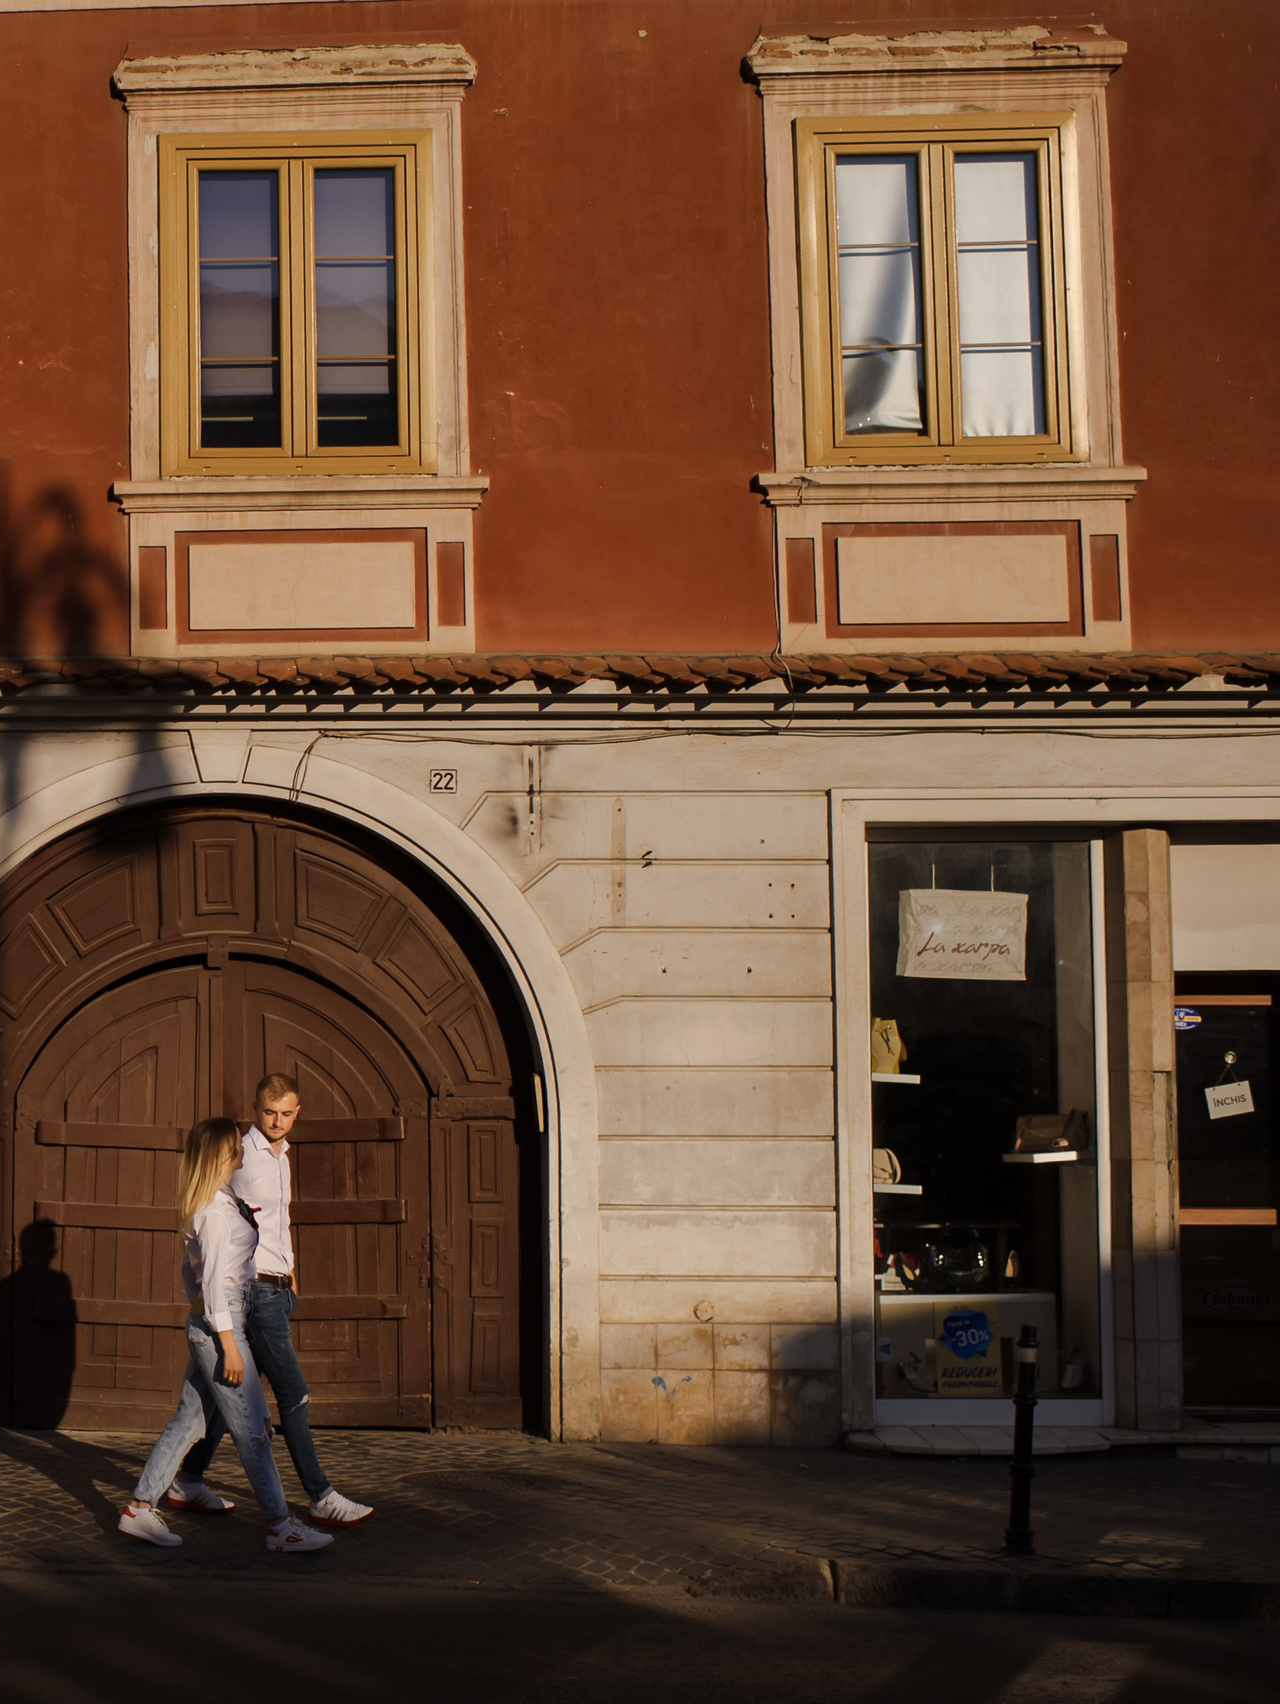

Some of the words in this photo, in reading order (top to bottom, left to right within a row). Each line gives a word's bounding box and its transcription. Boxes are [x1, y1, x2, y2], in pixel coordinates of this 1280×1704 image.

[433, 772, 454, 790] 22
[917, 931, 946, 957] La
[1213, 1094, 1247, 1107] ÎNCHIS
[1213, 1293, 1264, 1306] Johnny
[951, 1328, 989, 1347] -30%
